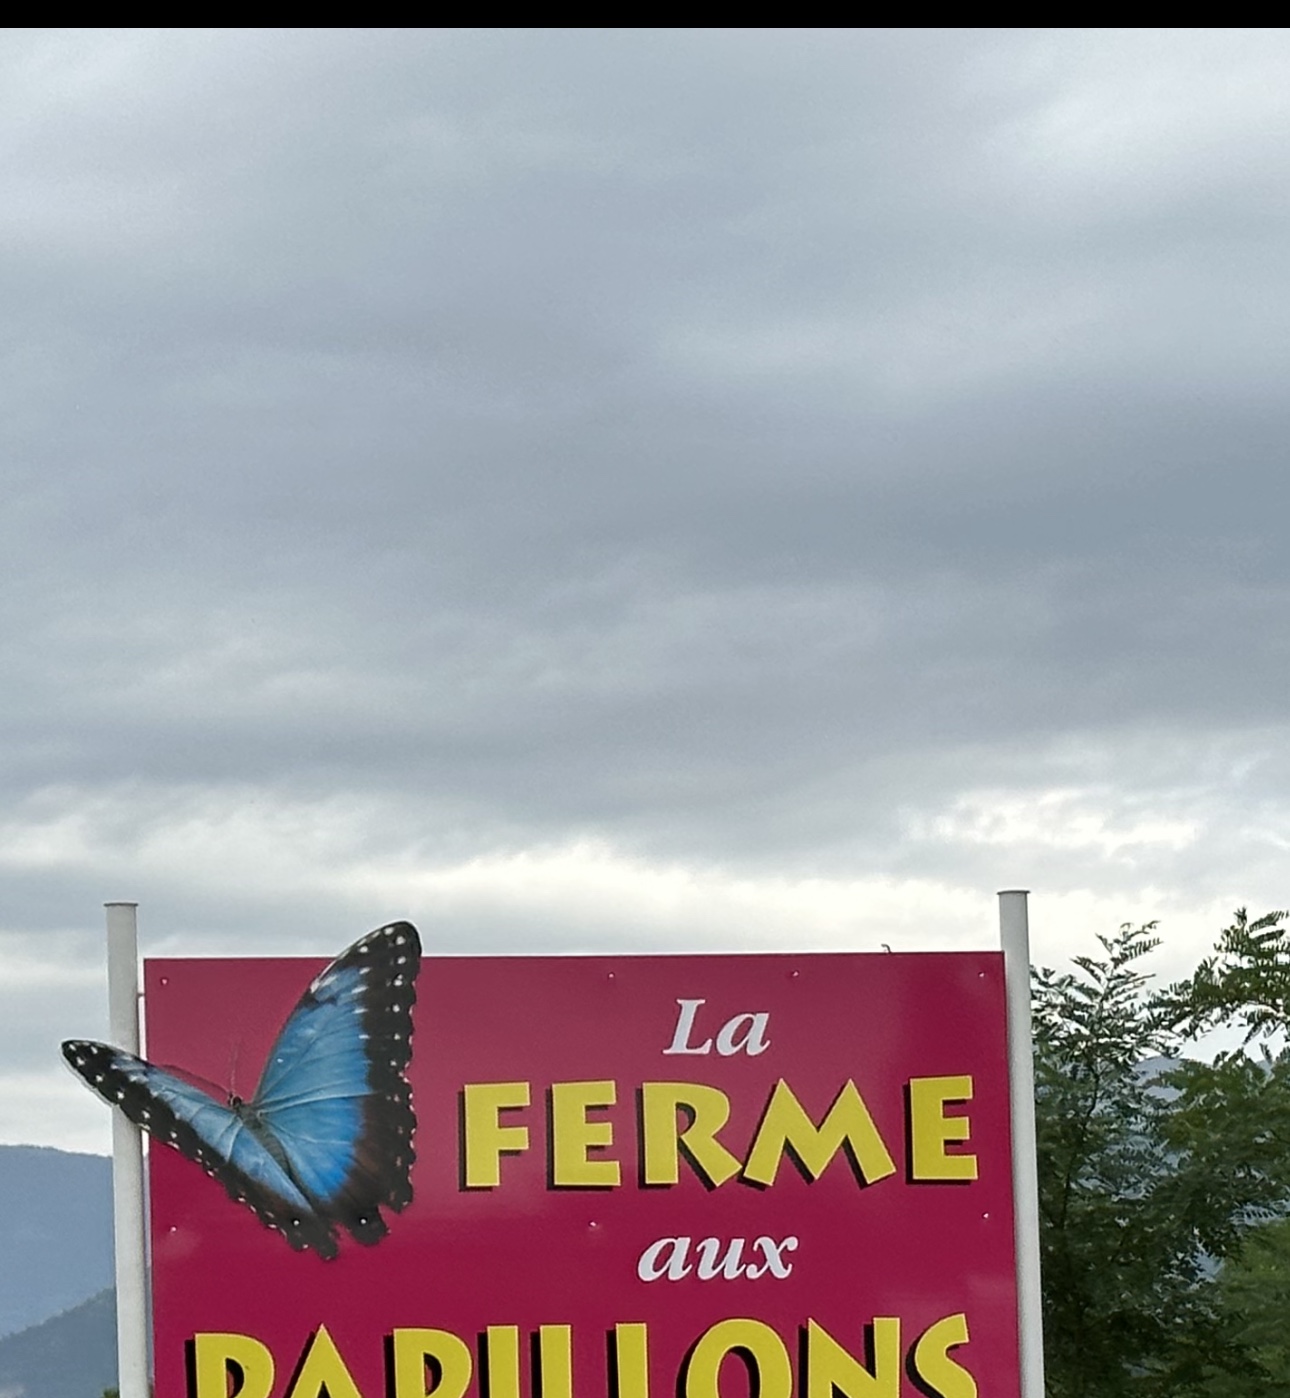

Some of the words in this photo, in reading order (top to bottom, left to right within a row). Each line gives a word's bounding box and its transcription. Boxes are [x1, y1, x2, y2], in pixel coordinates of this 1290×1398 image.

[662, 997, 771, 1057] La
[460, 1074, 980, 1189] FERME
[637, 1235, 799, 1282] aux
